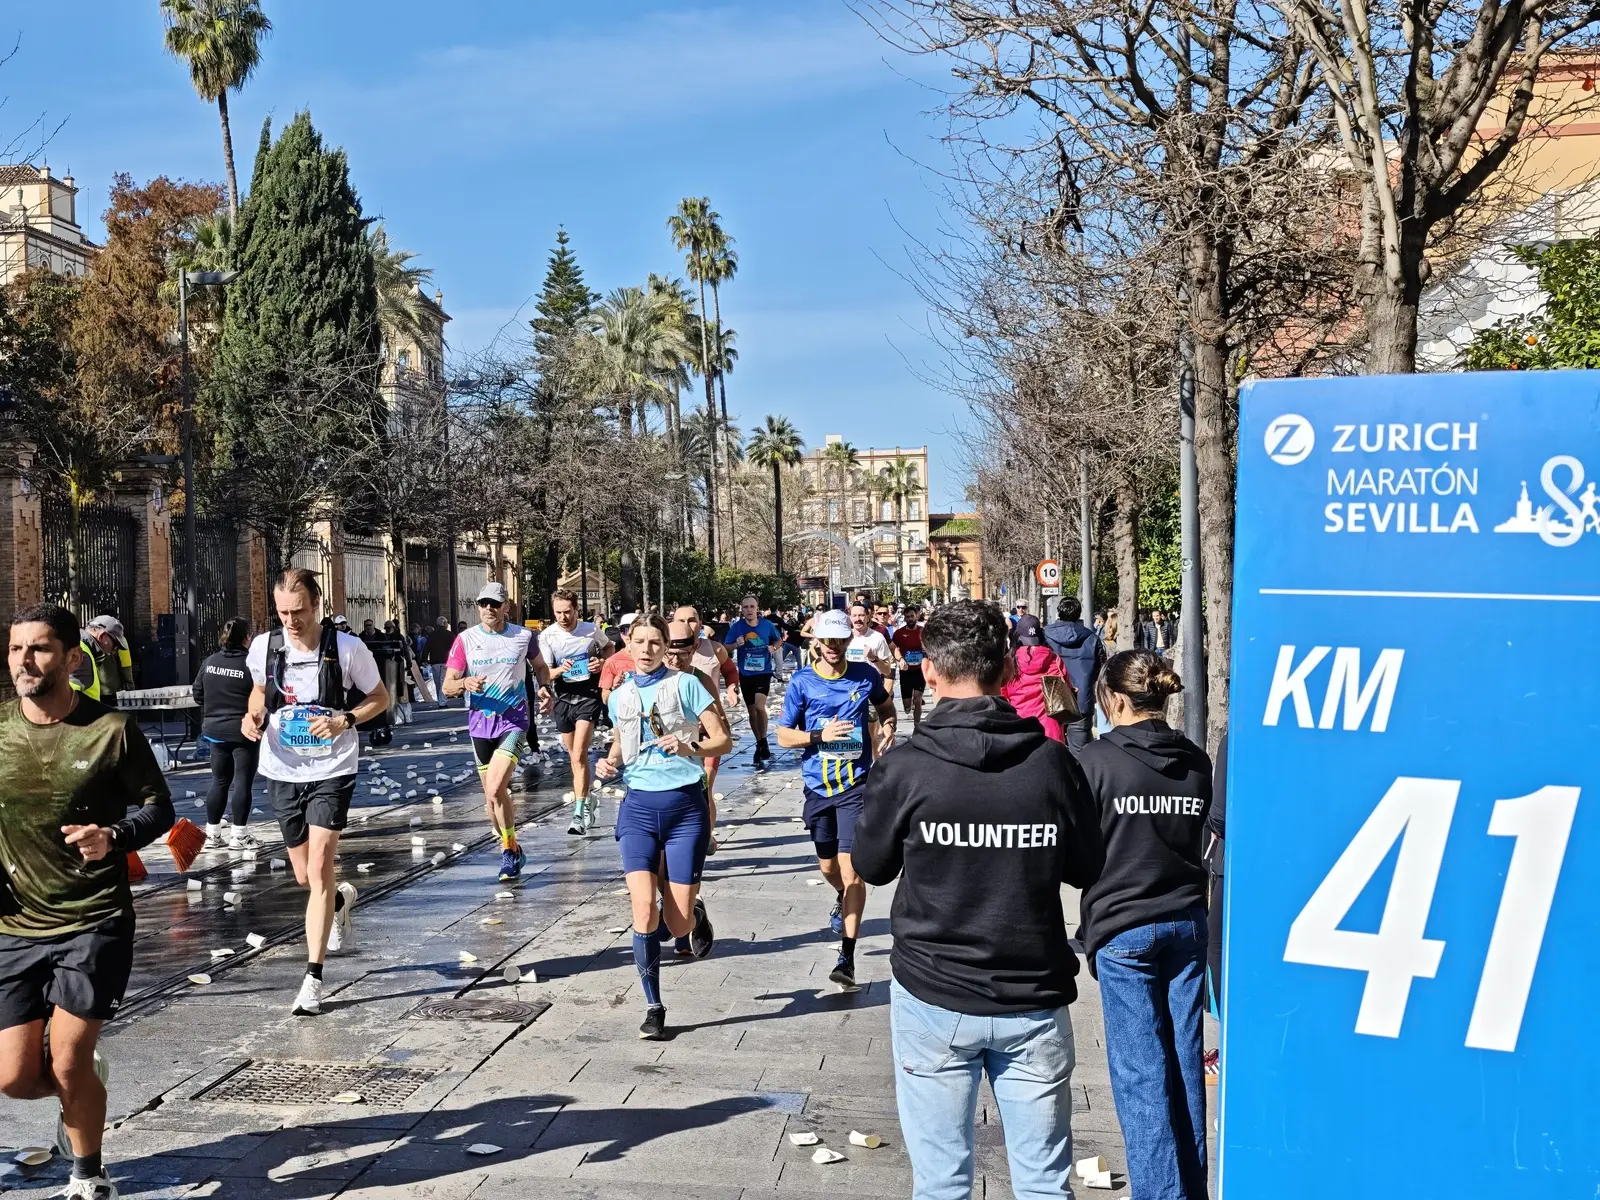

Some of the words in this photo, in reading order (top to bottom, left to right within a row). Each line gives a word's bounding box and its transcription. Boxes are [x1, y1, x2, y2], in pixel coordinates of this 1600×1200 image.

[1331, 421, 1478, 453] ZURICH
[1327, 461, 1479, 497] MARATÓN
[1324, 501, 1480, 534] SEVILLA
[1043, 568, 1057, 578] 10
[206, 665, 244, 679] VOLUNTEER
[471, 658, 493, 666] Next
[570, 668, 583, 677] BEN
[1262, 644, 1405, 733] KM
[290, 734, 320, 745] ROBIN
[818, 742, 840, 751] TIAGO
[841, 741, 863, 750] PINHO
[919, 820, 1058, 849] VOLUNTEER
[1282, 775, 1582, 1053] 41
